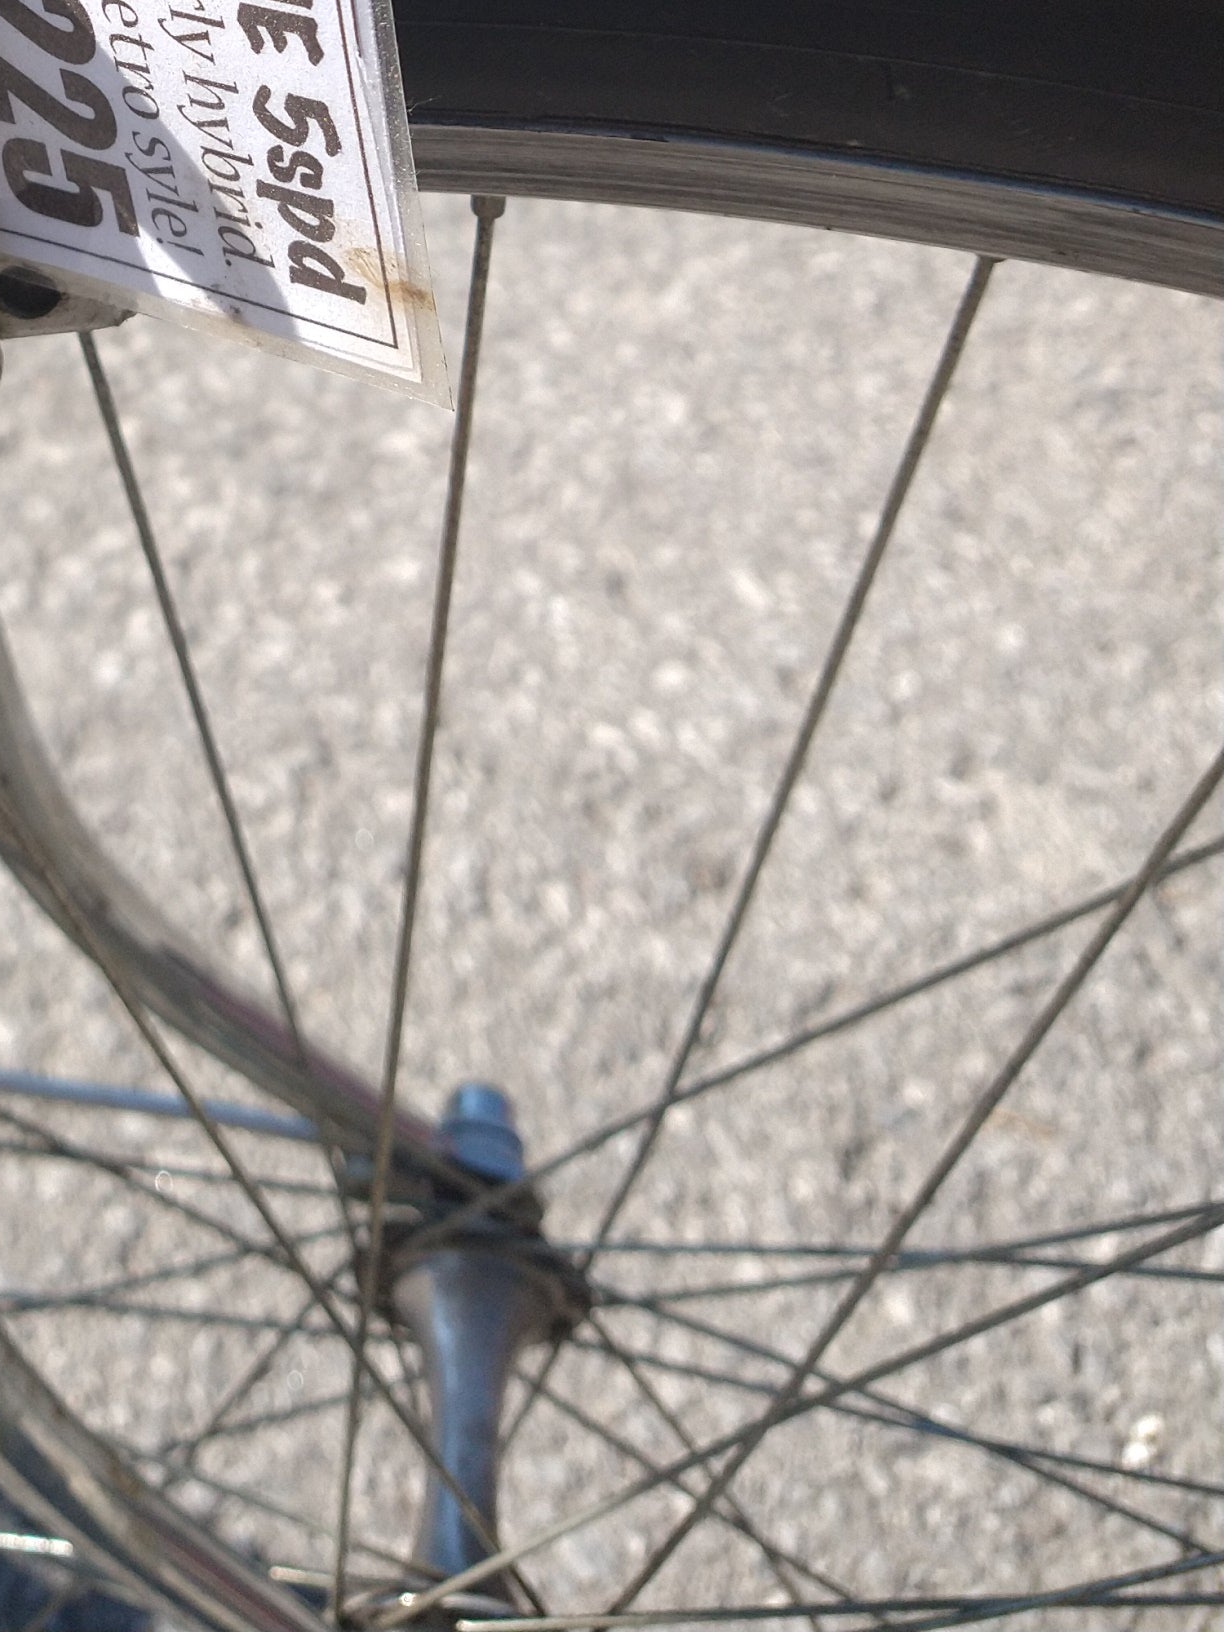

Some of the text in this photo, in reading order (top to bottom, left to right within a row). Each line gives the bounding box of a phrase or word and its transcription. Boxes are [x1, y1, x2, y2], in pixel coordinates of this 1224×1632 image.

[124, 130, 206, 257] syle!
[176, 69, 276, 269] hybrid.
[252, 84, 367, 306] 5spd
